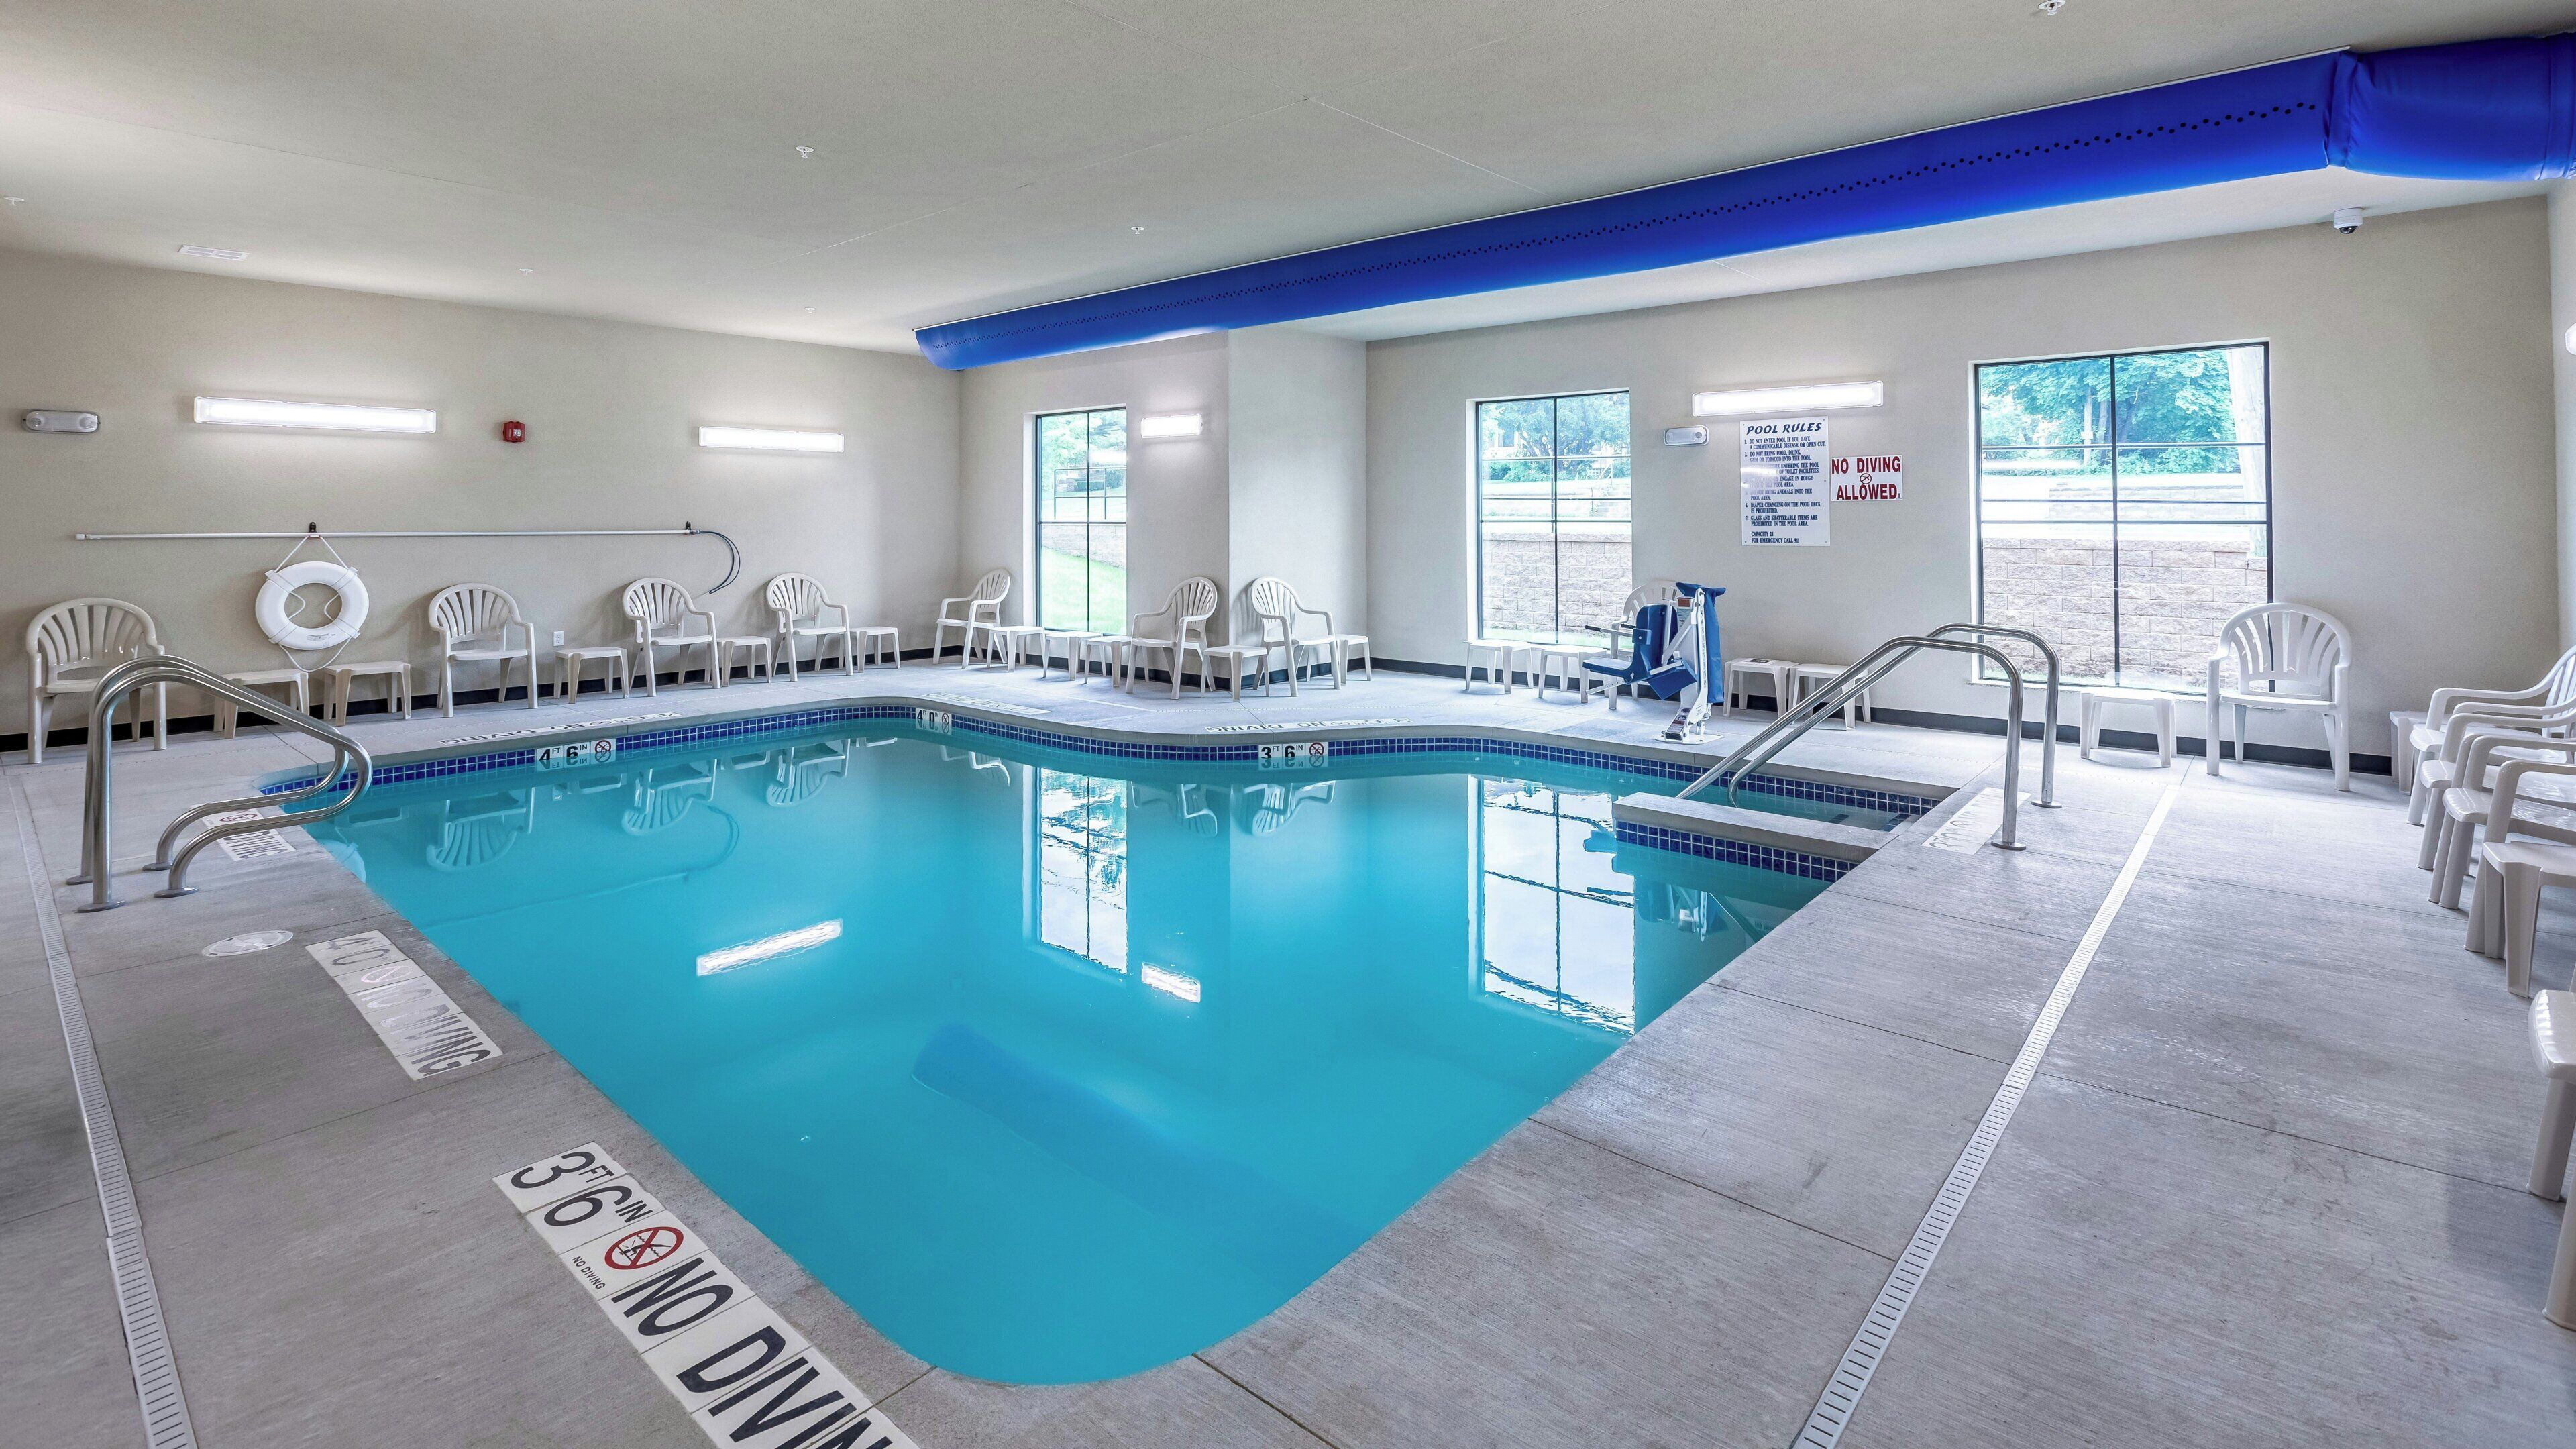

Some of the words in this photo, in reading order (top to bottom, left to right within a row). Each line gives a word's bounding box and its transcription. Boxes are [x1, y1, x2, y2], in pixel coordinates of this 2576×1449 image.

[1746, 425, 1778, 435] POOL
[1782, 423, 1821, 433] RULES
[1832, 458, 1849, 474] NO
[1857, 456, 1900, 473] DIVING
[441, 729, 536, 744] DIVING
[539, 749, 550, 760] 4
[566, 746, 578, 759] 6
[1261, 747, 1271, 759] 3
[1285, 745, 1295, 757] 6
[223, 830, 288, 858] DIVING
[380, 1004, 491, 1076] DIVING
[511, 1152, 596, 1189] 3
[578, 1165, 614, 1183] FT
[544, 1185, 632, 1226] 6
[615, 1200, 653, 1222] IN
[572, 1256, 585, 1267] NO
[581, 1266, 605, 1289] DIVING
[610, 1257, 733, 1336] NO
